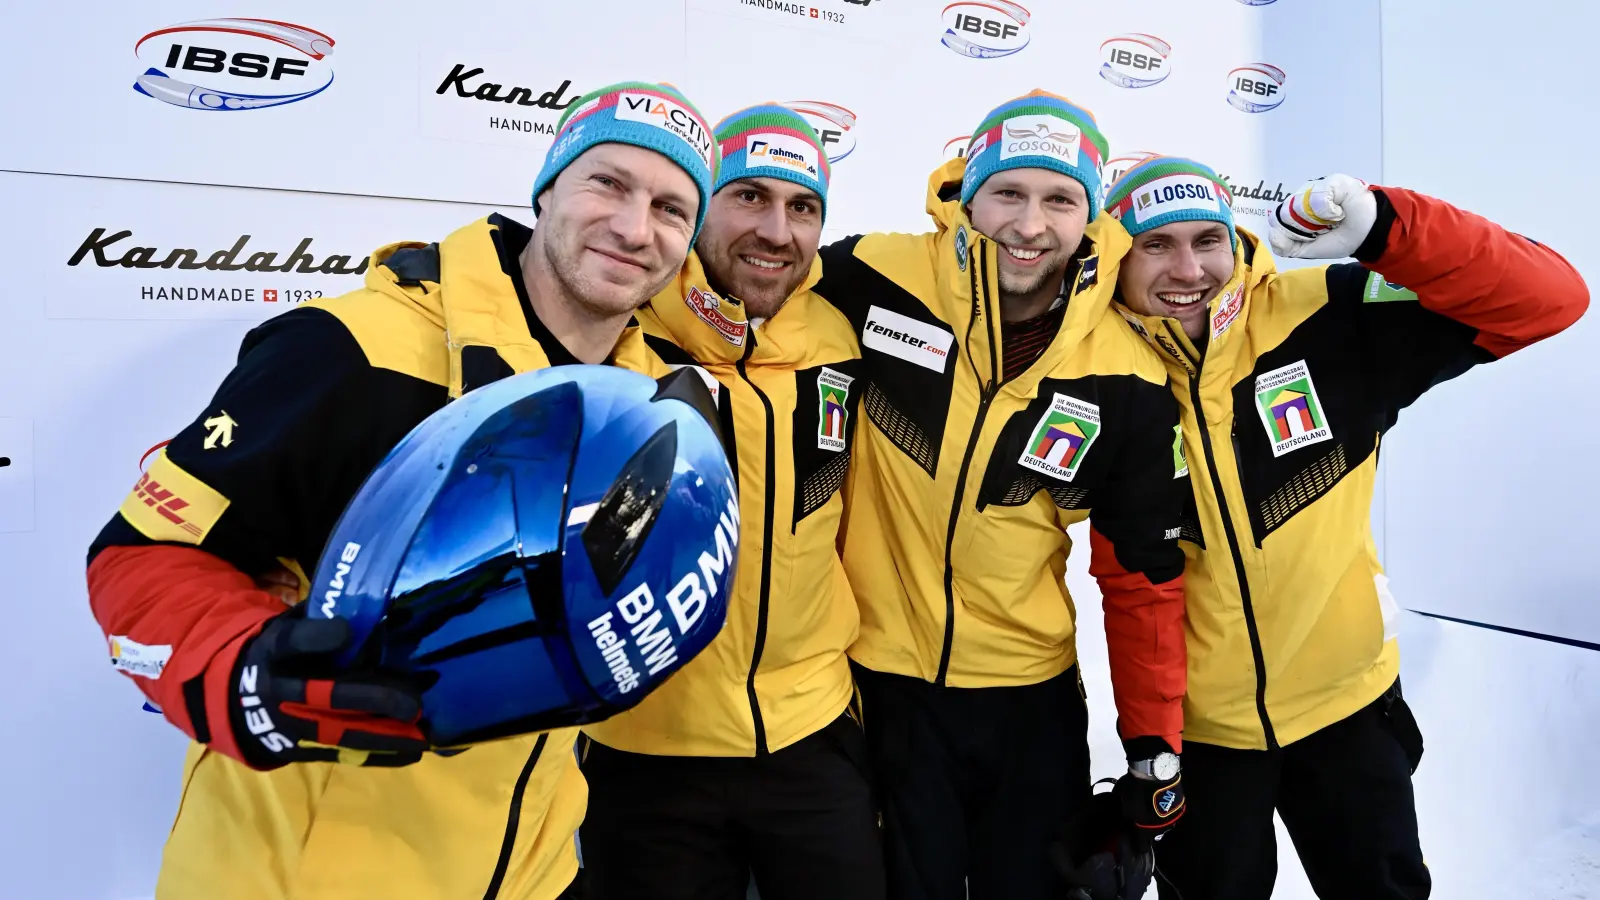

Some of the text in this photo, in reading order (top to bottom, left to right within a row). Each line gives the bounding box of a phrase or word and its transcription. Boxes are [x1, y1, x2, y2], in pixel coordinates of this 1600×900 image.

[822, 11, 845, 24] 1932
[954, 13, 1019, 40] IBSF
[165, 44, 310, 81] IBSF
[1110, 48, 1162, 72] IBSF
[1235, 77, 1279, 98] IBSF
[490, 117, 555, 135] HANDMA
[625, 97, 710, 151] VIACTIV
[769, 147, 804, 162] rahmen
[1008, 140, 1071, 159] COSONA
[1153, 183, 1215, 205] LOGSOL
[1232, 206, 1266, 217] HANDMADE
[141, 286, 256, 303] HANDMADE
[707, 310, 741, 335] DOERR
[865, 320, 947, 357] fenster.com
[1276, 429, 1327, 452] DEUTSCHLAND
[1024, 456, 1072, 478] DEUTSCHLAND
[133, 471, 190, 525] DHL
[321, 541, 361, 620] BMW
[616, 582, 679, 677] BMW
[587, 611, 641, 694] helmets
[239, 664, 294, 753] SEIZ
